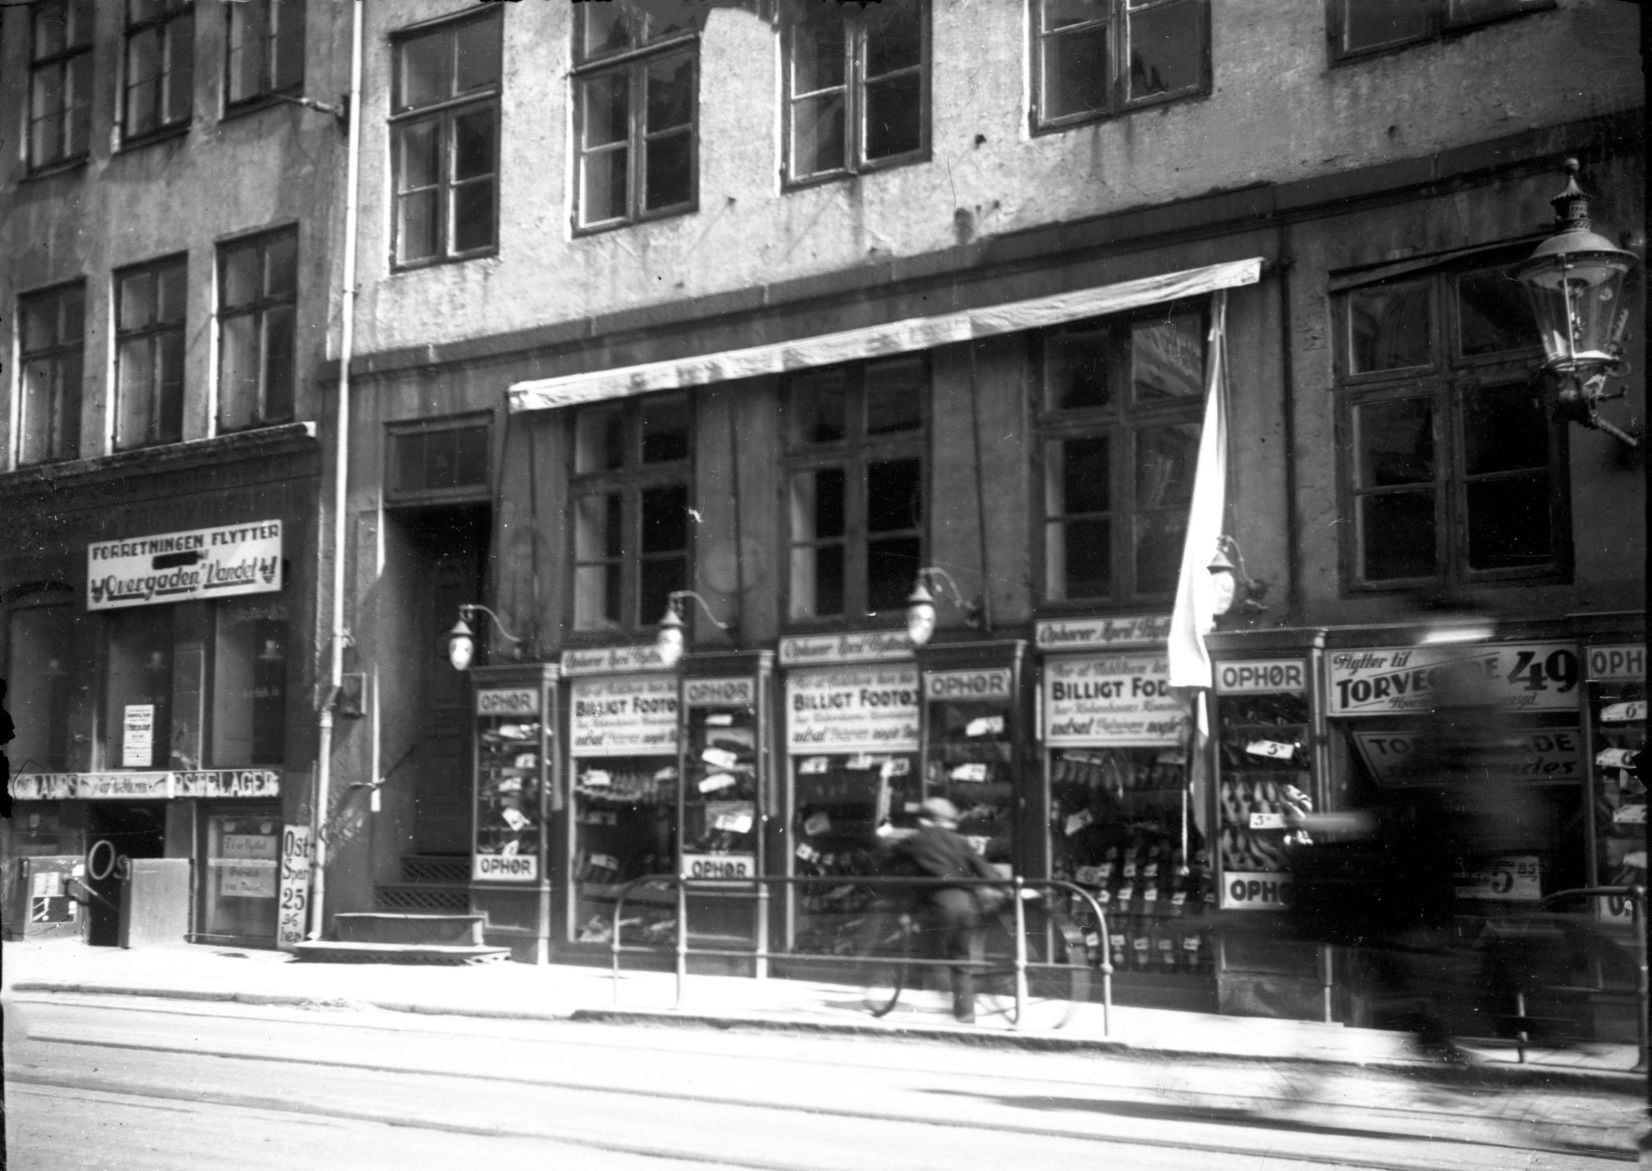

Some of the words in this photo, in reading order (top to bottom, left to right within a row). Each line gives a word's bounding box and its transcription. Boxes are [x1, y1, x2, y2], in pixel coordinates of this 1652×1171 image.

[92, 534, 204, 560] FORRETNINGEN
[212, 524, 279, 546] FLYTTER
[105, 567, 199, 600] Overgaden
[1332, 652, 1388, 676] Flytter
[1391, 649, 1413, 668] til
[1507, 648, 1578, 693] 49
[931, 674, 1005, 695] OPHØR
[1223, 666, 1303, 687] OPHØR
[688, 683, 750, 701] OPHØR
[793, 692, 853, 710] BILLIGT
[1053, 680, 1124, 701] BILLIGT
[482, 692, 531, 711] OPHØR
[284, 830, 309, 858] Ost
[480, 857, 532, 875] OPHØR
[691, 860, 747, 877] OPHØR
[1491, 861, 1514, 894] 5
[281, 887, 305, 911] 25
